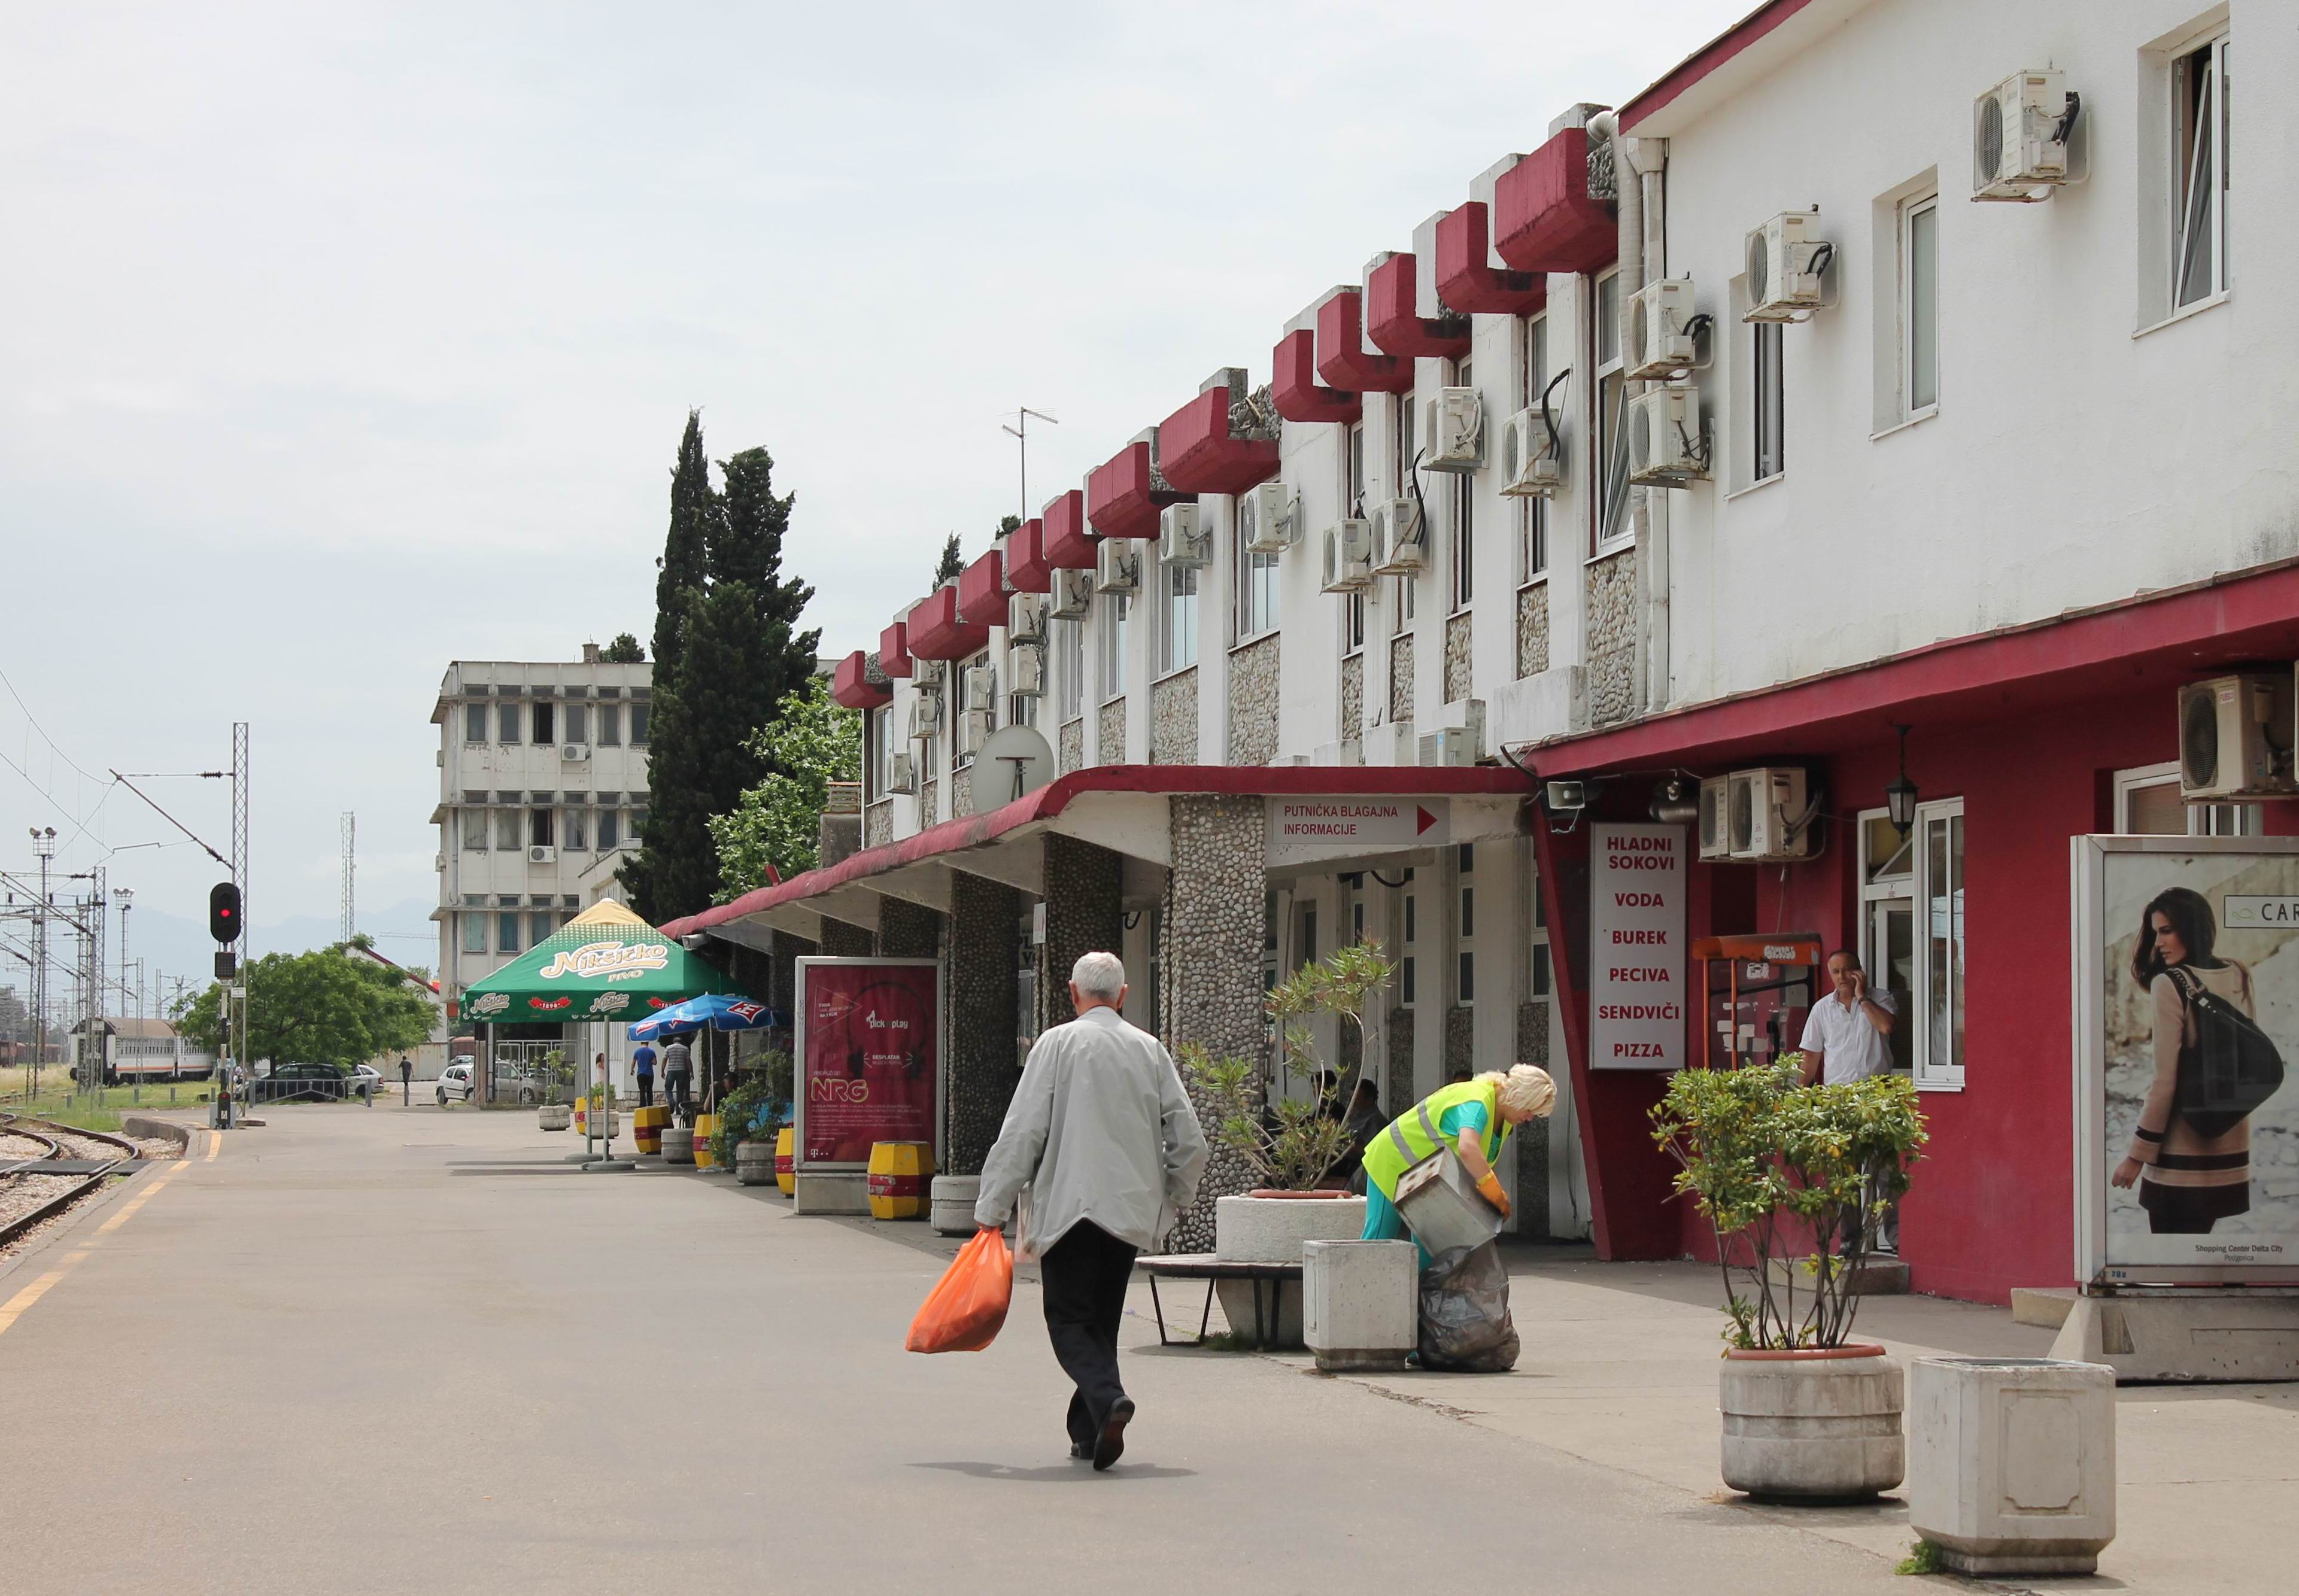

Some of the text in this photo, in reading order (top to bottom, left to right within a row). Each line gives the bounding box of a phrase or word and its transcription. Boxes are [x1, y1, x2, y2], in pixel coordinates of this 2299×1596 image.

[1284, 803, 1398, 817] PUTNIČKA BLAGAJNA
[1284, 823, 1356, 835] INFORMACIJE
[1607, 836, 1672, 852] HLADNI
[1608, 855, 1675, 871] SOKOVI
[1615, 892, 1664, 908] VODA
[2261, 903, 2299, 921] CAR
[1612, 930, 1667, 945] BUREK
[1609, 967, 1670, 983] PECIVA
[1599, 1001, 1680, 1020] SENDVIČI
[1614, 1043, 1664, 1058] PIZZA
[811, 1077, 869, 1103] NRG
[2195, 1245, 2227, 1253] Shopping
[2271, 1245, 2283, 1253] City
[2224, 1254, 2255, 1263] Podgorica
